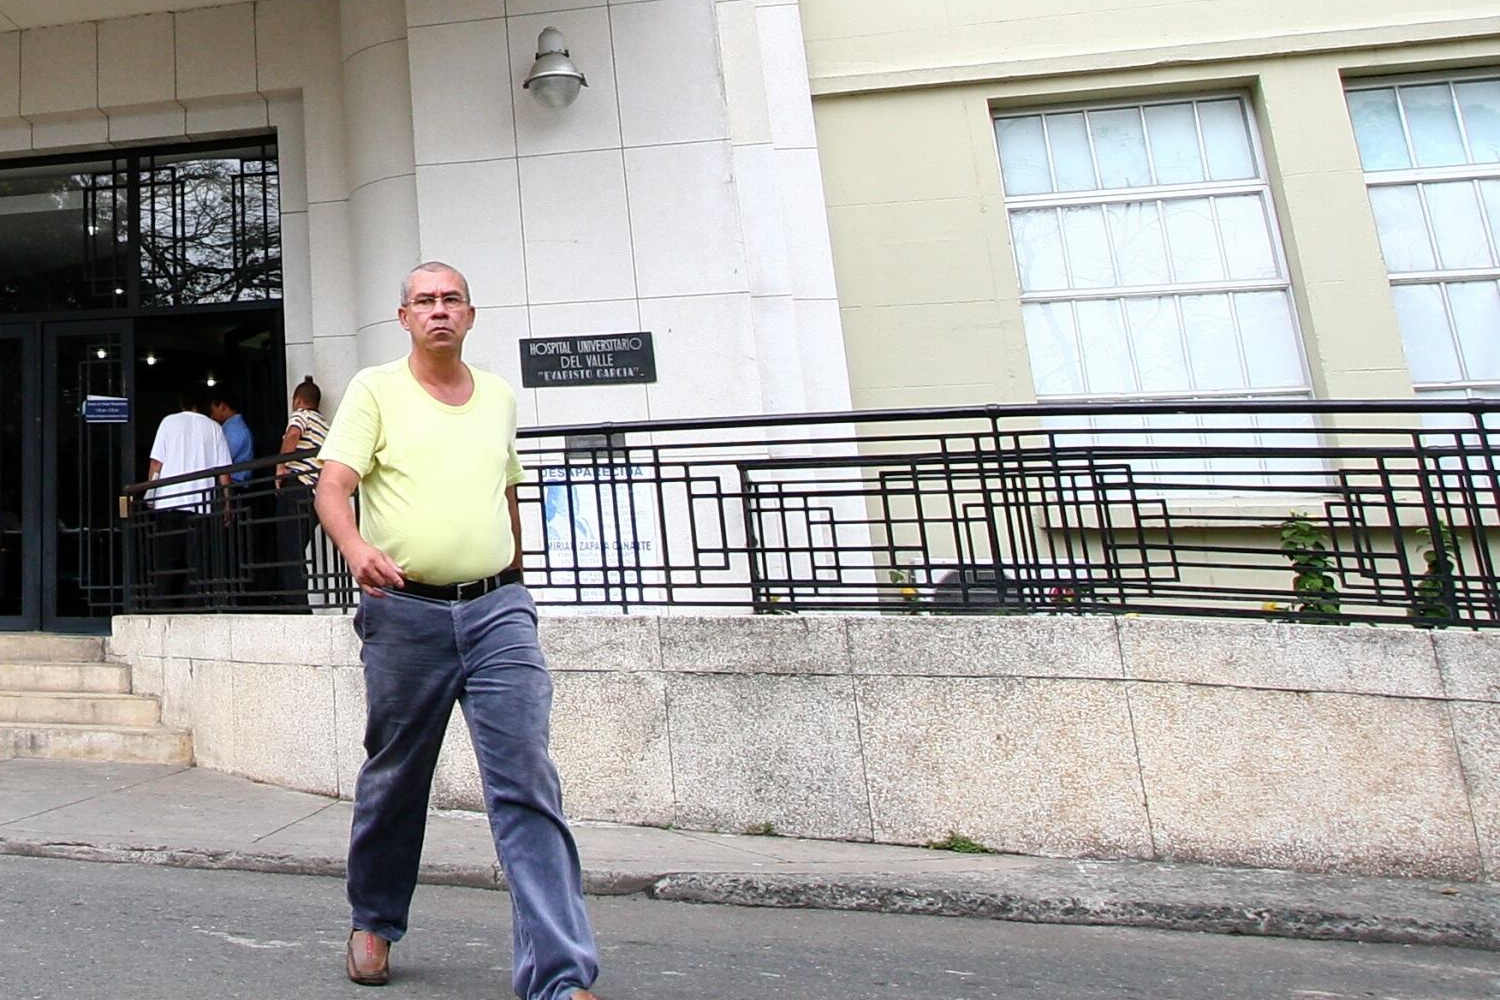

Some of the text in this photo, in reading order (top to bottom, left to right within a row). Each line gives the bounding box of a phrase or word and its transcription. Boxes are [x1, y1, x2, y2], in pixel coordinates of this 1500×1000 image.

[529, 337, 642, 356] HOSPITAL UNIVERSITARIO
[560, 353, 614, 369] DEL VALLE
[580, 541, 609, 551] ZAPAA
